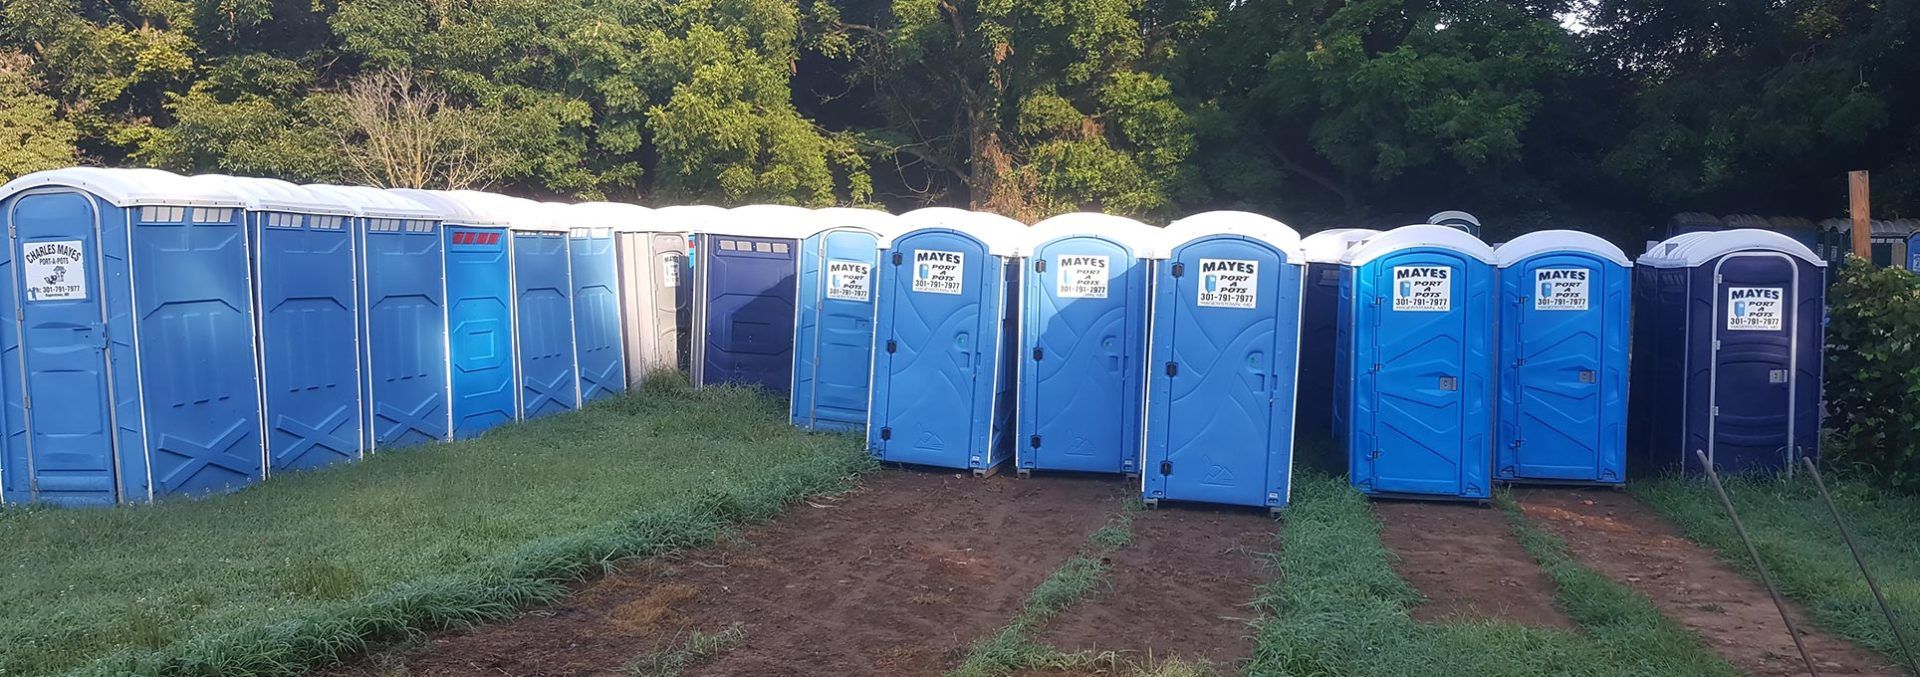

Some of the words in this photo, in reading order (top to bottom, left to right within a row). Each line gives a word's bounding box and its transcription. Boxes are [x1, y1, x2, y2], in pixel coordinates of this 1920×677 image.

[25, 244, 56, 264] CHARLES
[57, 244, 81, 262] MAYES
[917, 252, 961, 264] MAYES
[1061, 257, 1105, 268] MAYES
[1202, 261, 1255, 274] MAYES
[830, 263, 868, 275] MAYES
[1396, 267, 1448, 280] MAYES
[1538, 270, 1586, 282] MAYES
[915, 279, 960, 290] 301-791-7977
[1200, 292, 1254, 303] 301-791-7977
[1731, 288, 1780, 300] MAYES
[1395, 298, 1448, 306] 301-791-7977
[1537, 298, 1586, 306] 301-791-7977
[1730, 317, 1780, 325] 301-791-7977
